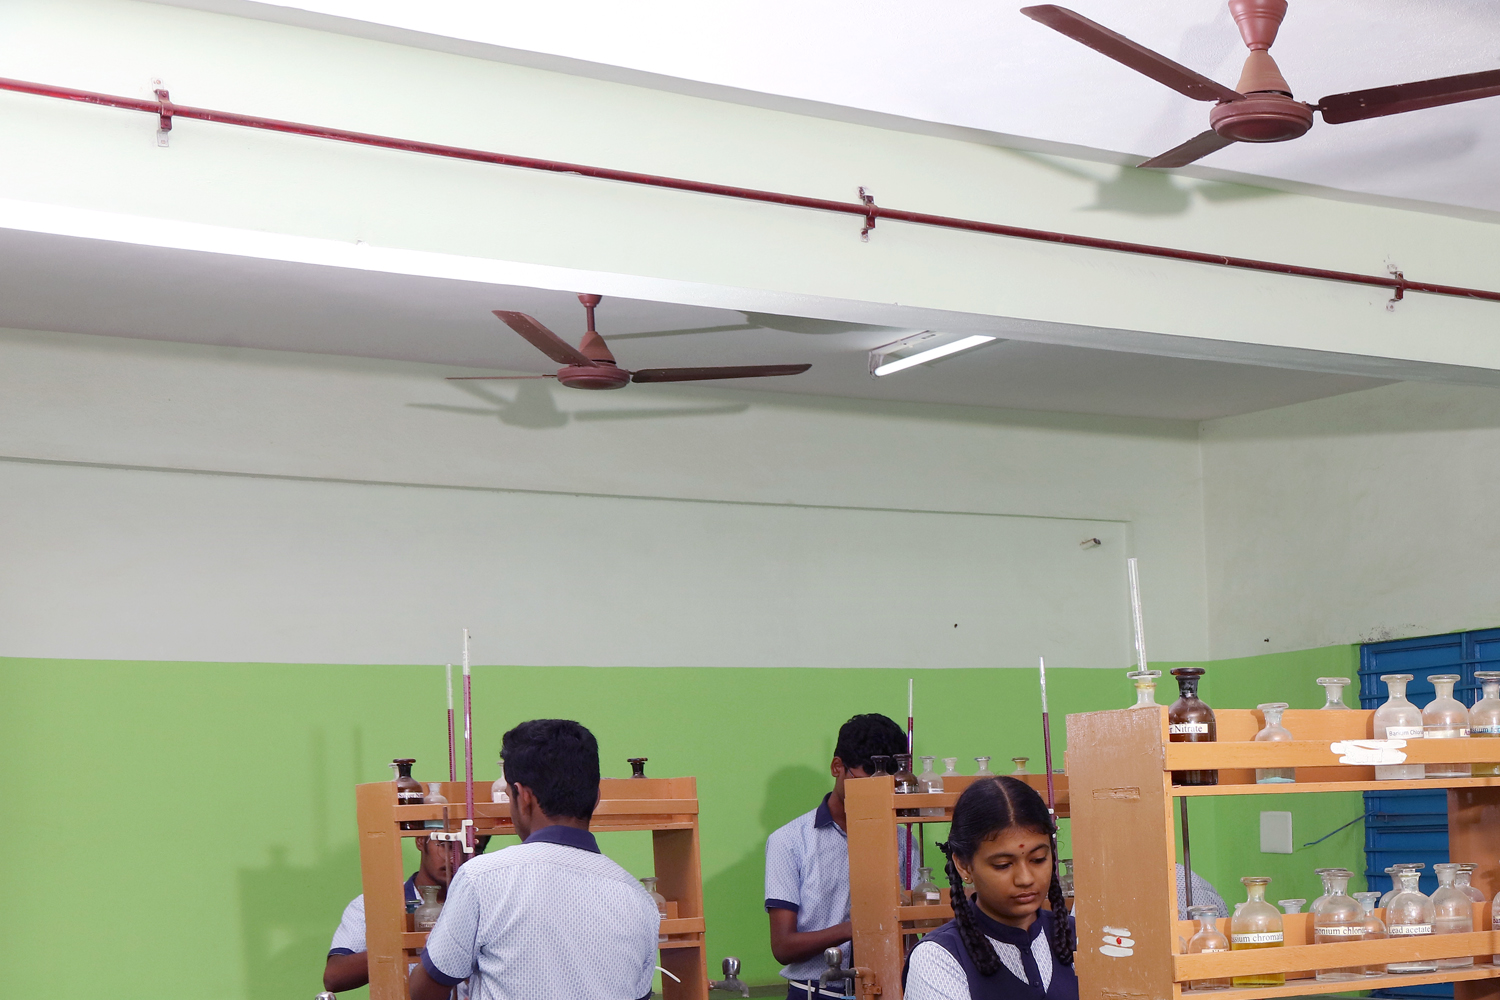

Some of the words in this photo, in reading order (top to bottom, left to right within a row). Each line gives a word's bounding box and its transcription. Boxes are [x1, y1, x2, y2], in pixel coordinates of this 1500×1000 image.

[1174, 724, 1203, 733] Nitrate
[1388, 925, 1404, 934] Lead
[1405, 925, 1431, 934] acetate
